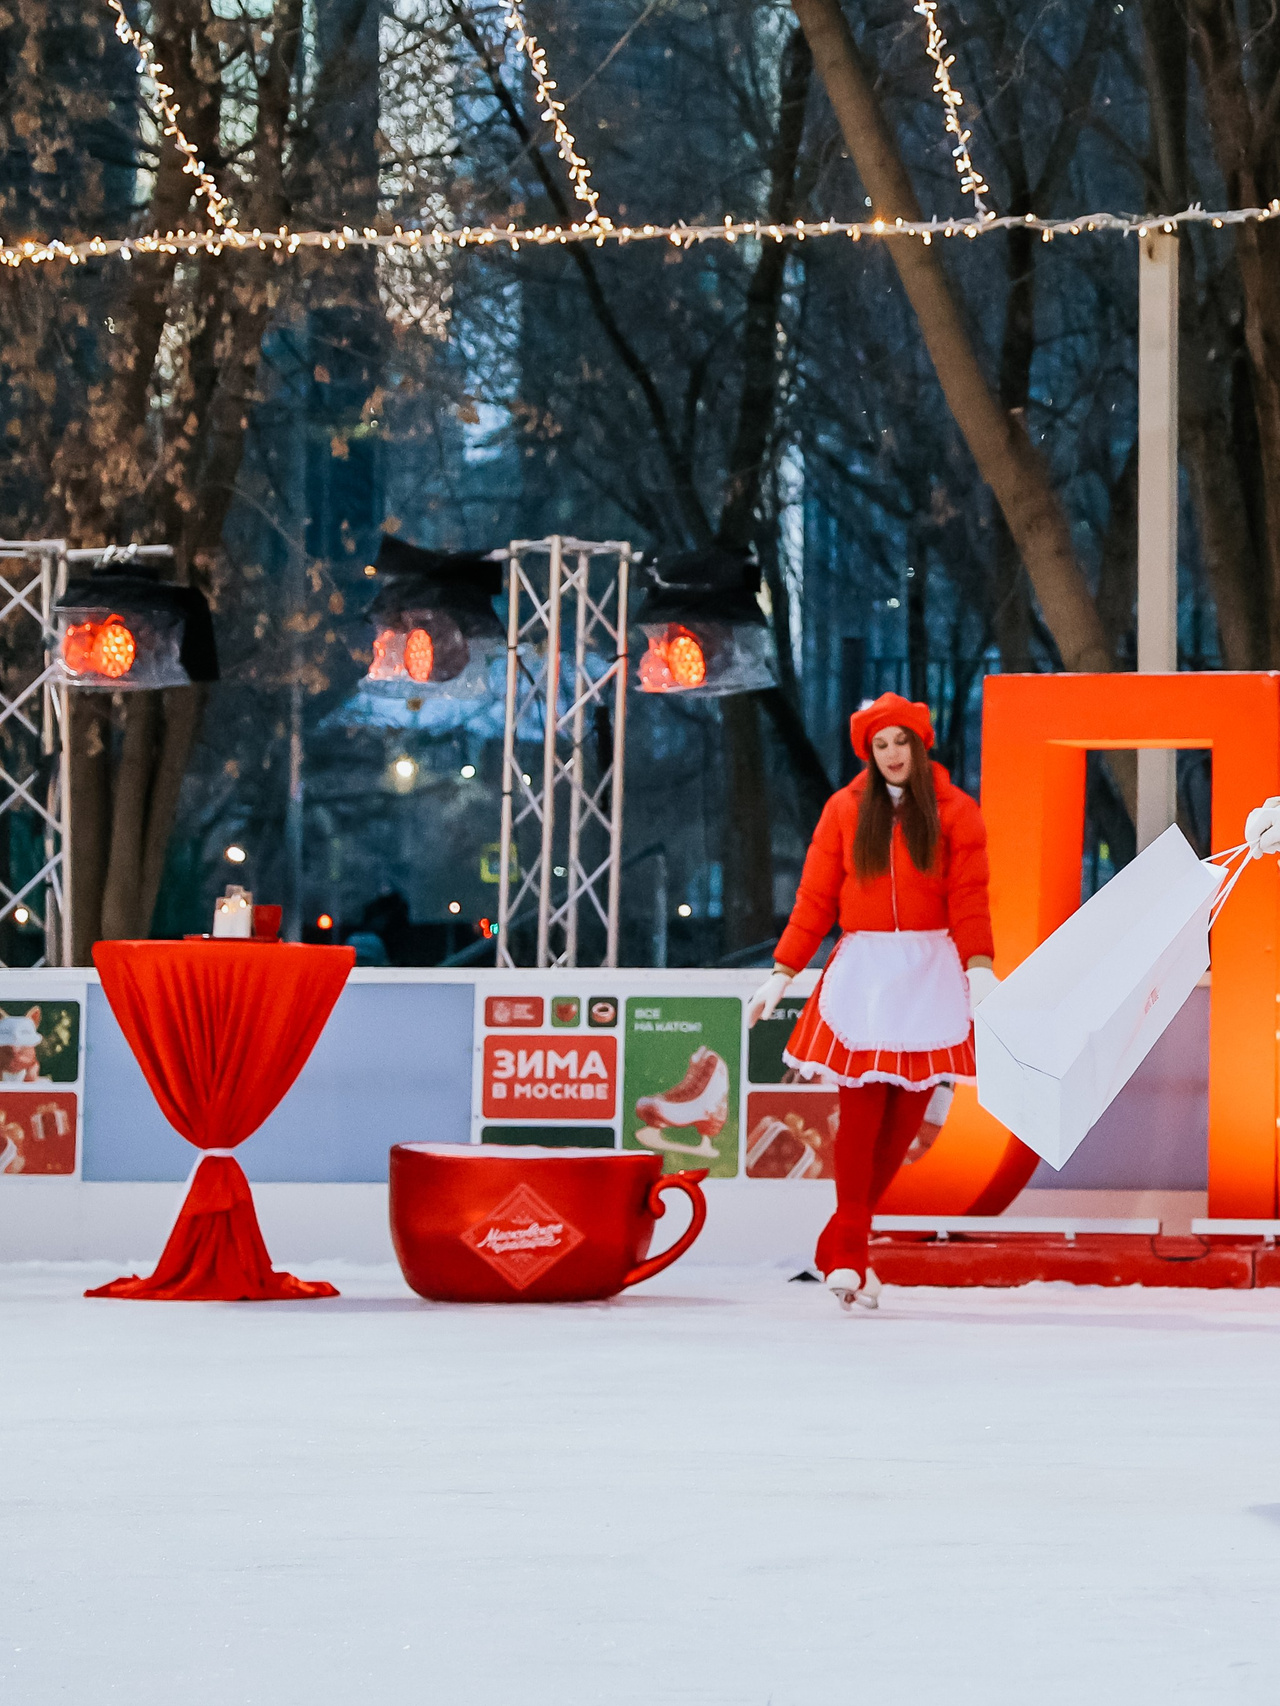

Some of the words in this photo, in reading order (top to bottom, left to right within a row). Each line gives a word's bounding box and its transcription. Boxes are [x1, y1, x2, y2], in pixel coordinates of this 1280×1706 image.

[492, 1049, 608, 1079] ЗИМА
[492, 1082, 507, 1099] В
[514, 1082, 609, 1100] МОСКВЕ
